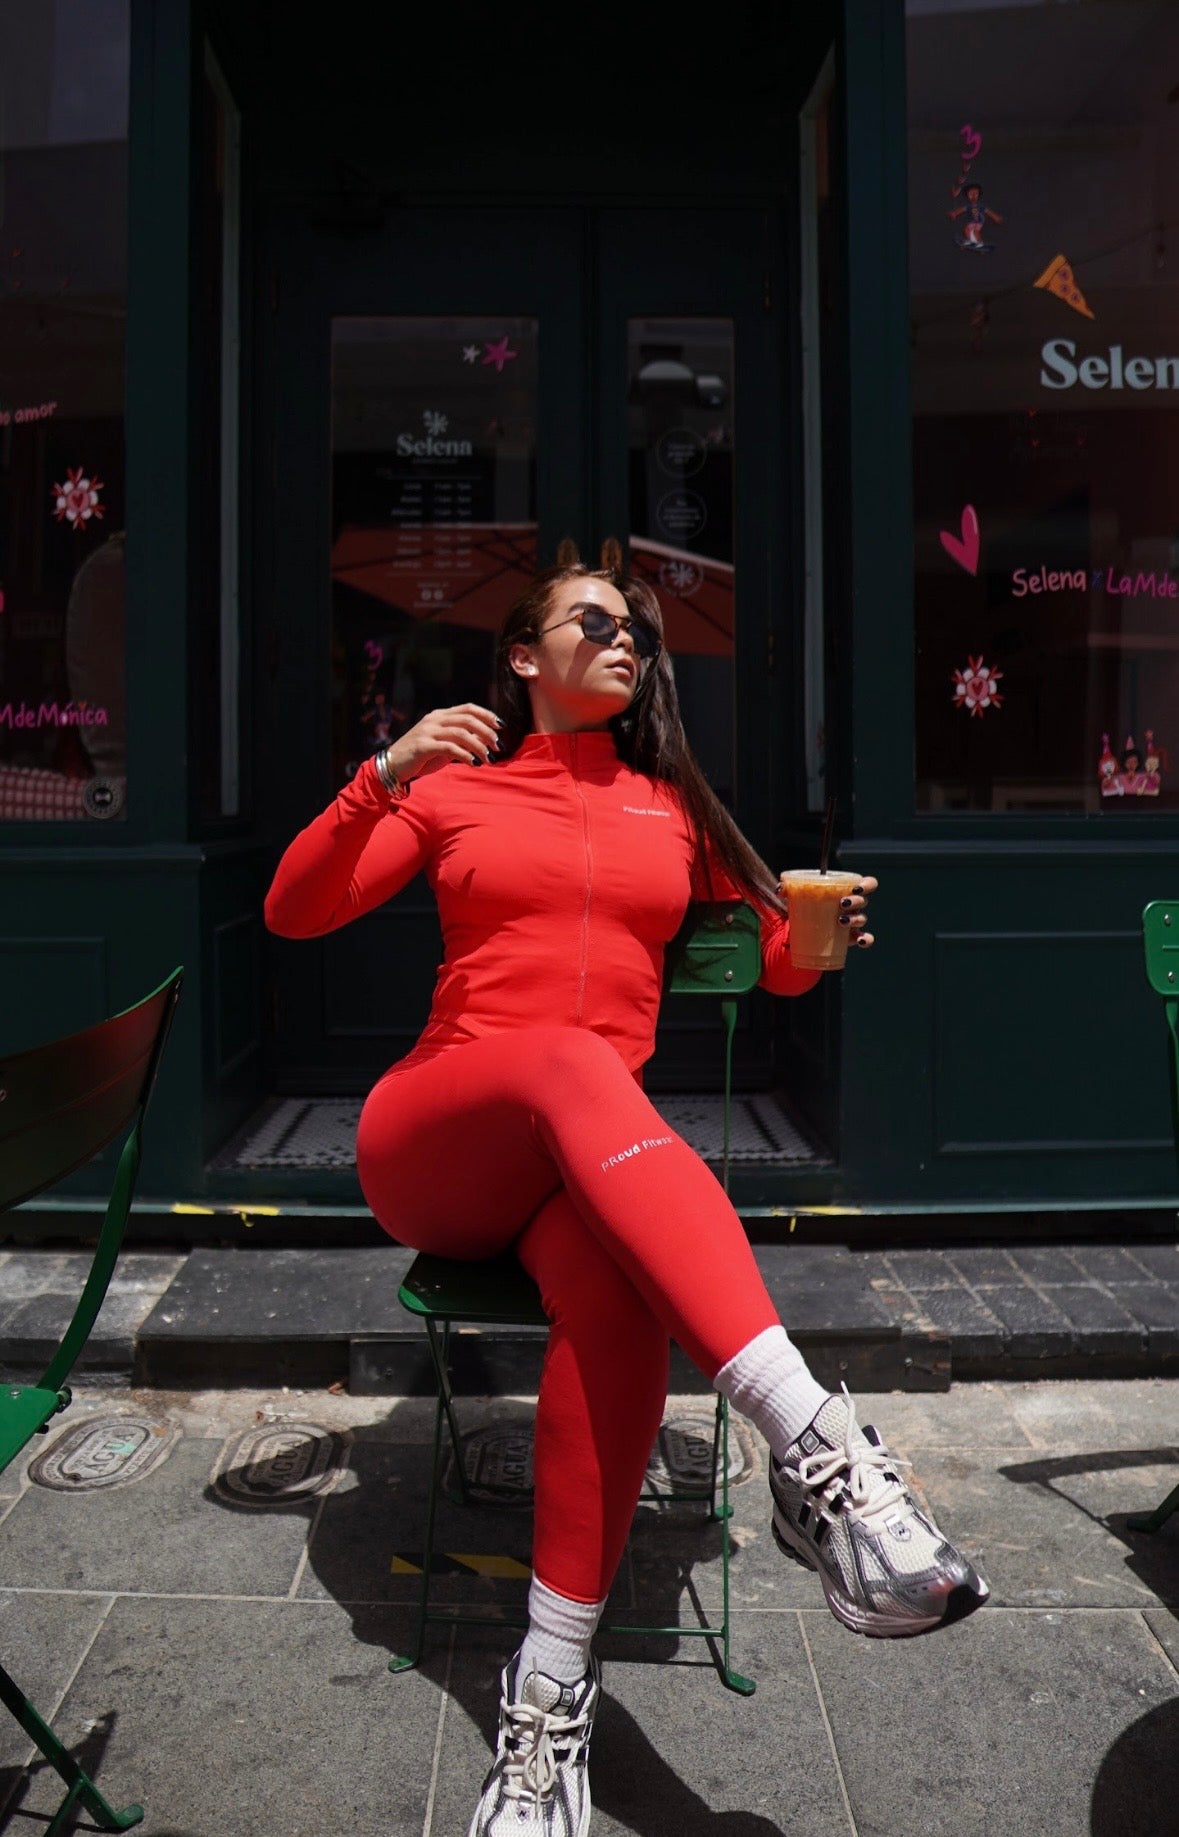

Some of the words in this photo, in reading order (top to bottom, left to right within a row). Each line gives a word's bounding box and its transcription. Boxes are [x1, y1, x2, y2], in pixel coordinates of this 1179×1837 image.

[15, 401, 58, 422] amor
[397, 432, 473, 456] Selena
[1012, 565, 1087, 597] Selena
[86, 1432, 136, 1474] AGUA
[269, 1438, 302, 1481] AGUA
[503, 1444, 529, 1487] AGUA
